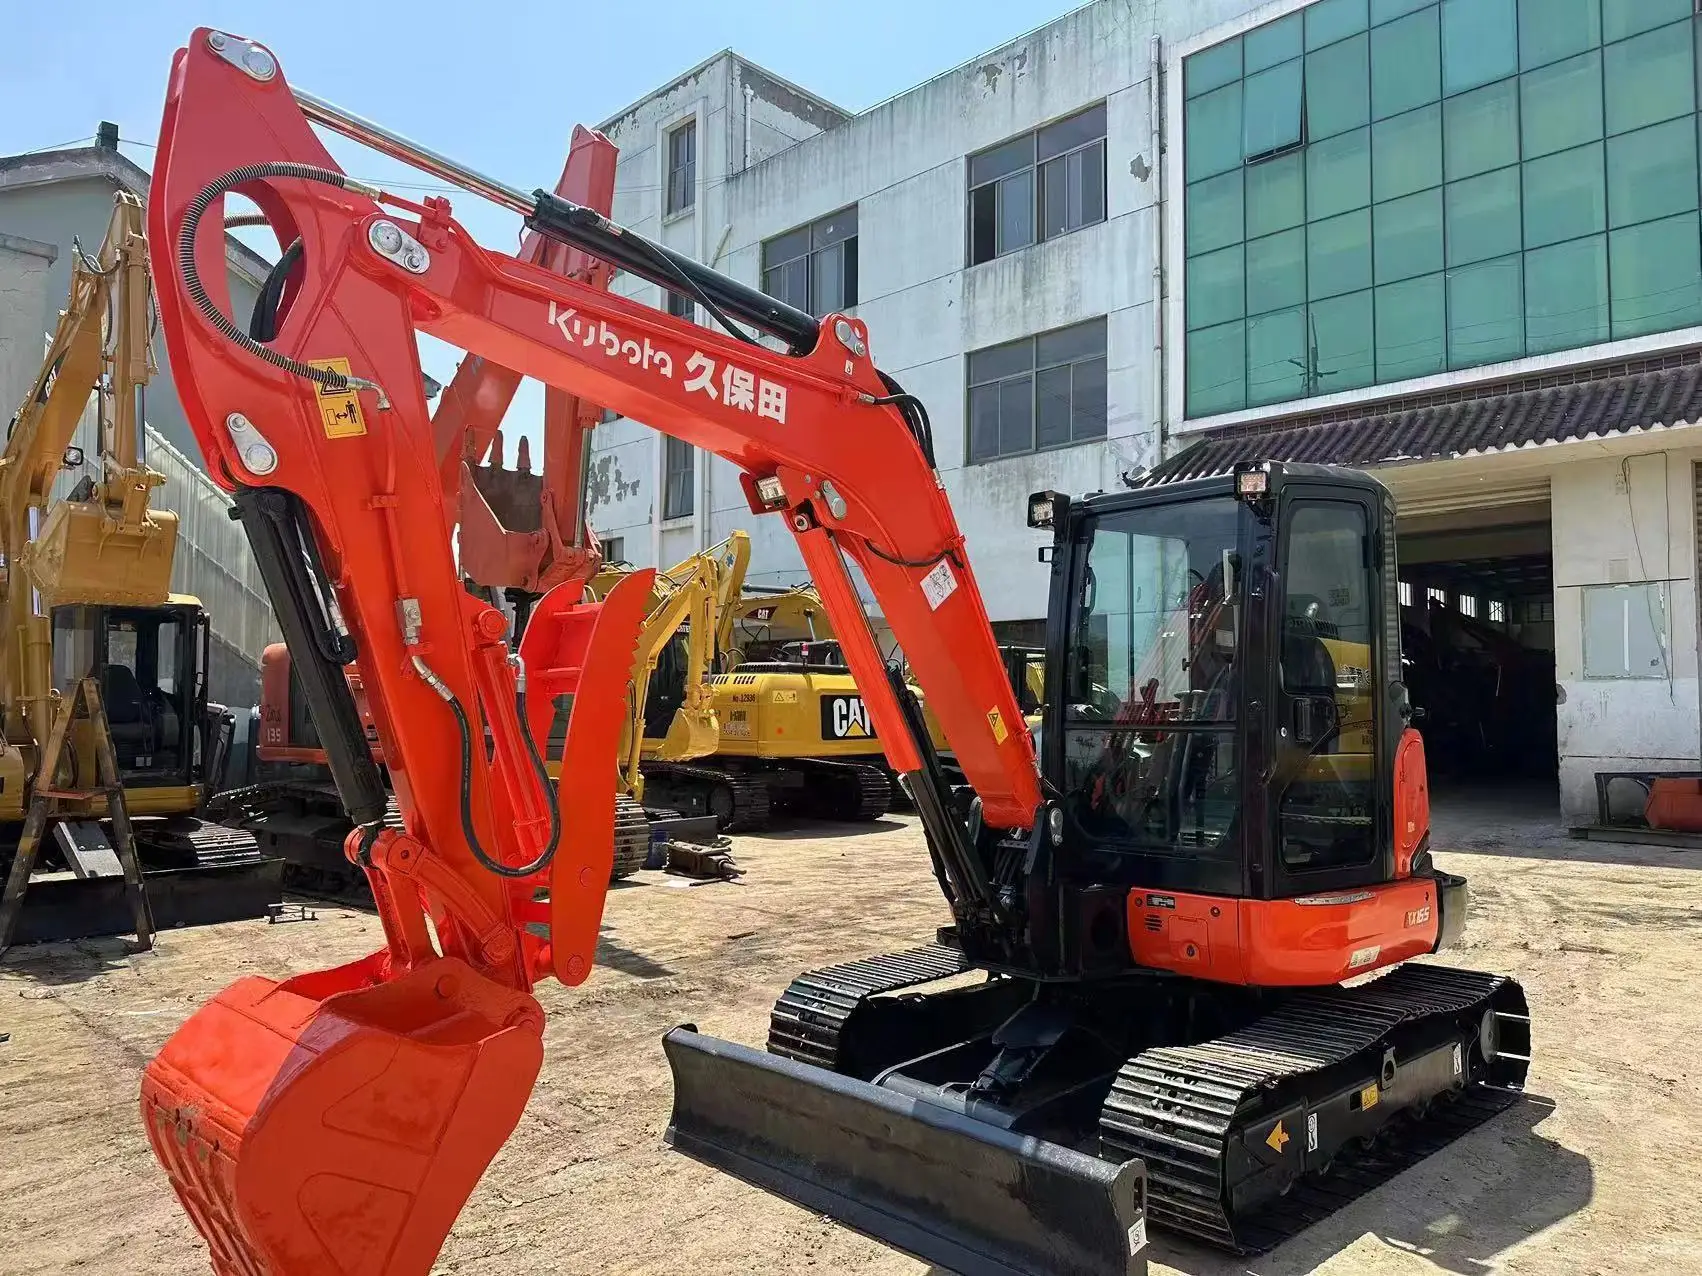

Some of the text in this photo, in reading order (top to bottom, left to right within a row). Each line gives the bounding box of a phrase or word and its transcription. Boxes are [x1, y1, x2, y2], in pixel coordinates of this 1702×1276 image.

[547, 301, 788, 425] Kubota 久保田
[757, 609, 770, 620] CAT
[832, 698, 871, 737] CAT
